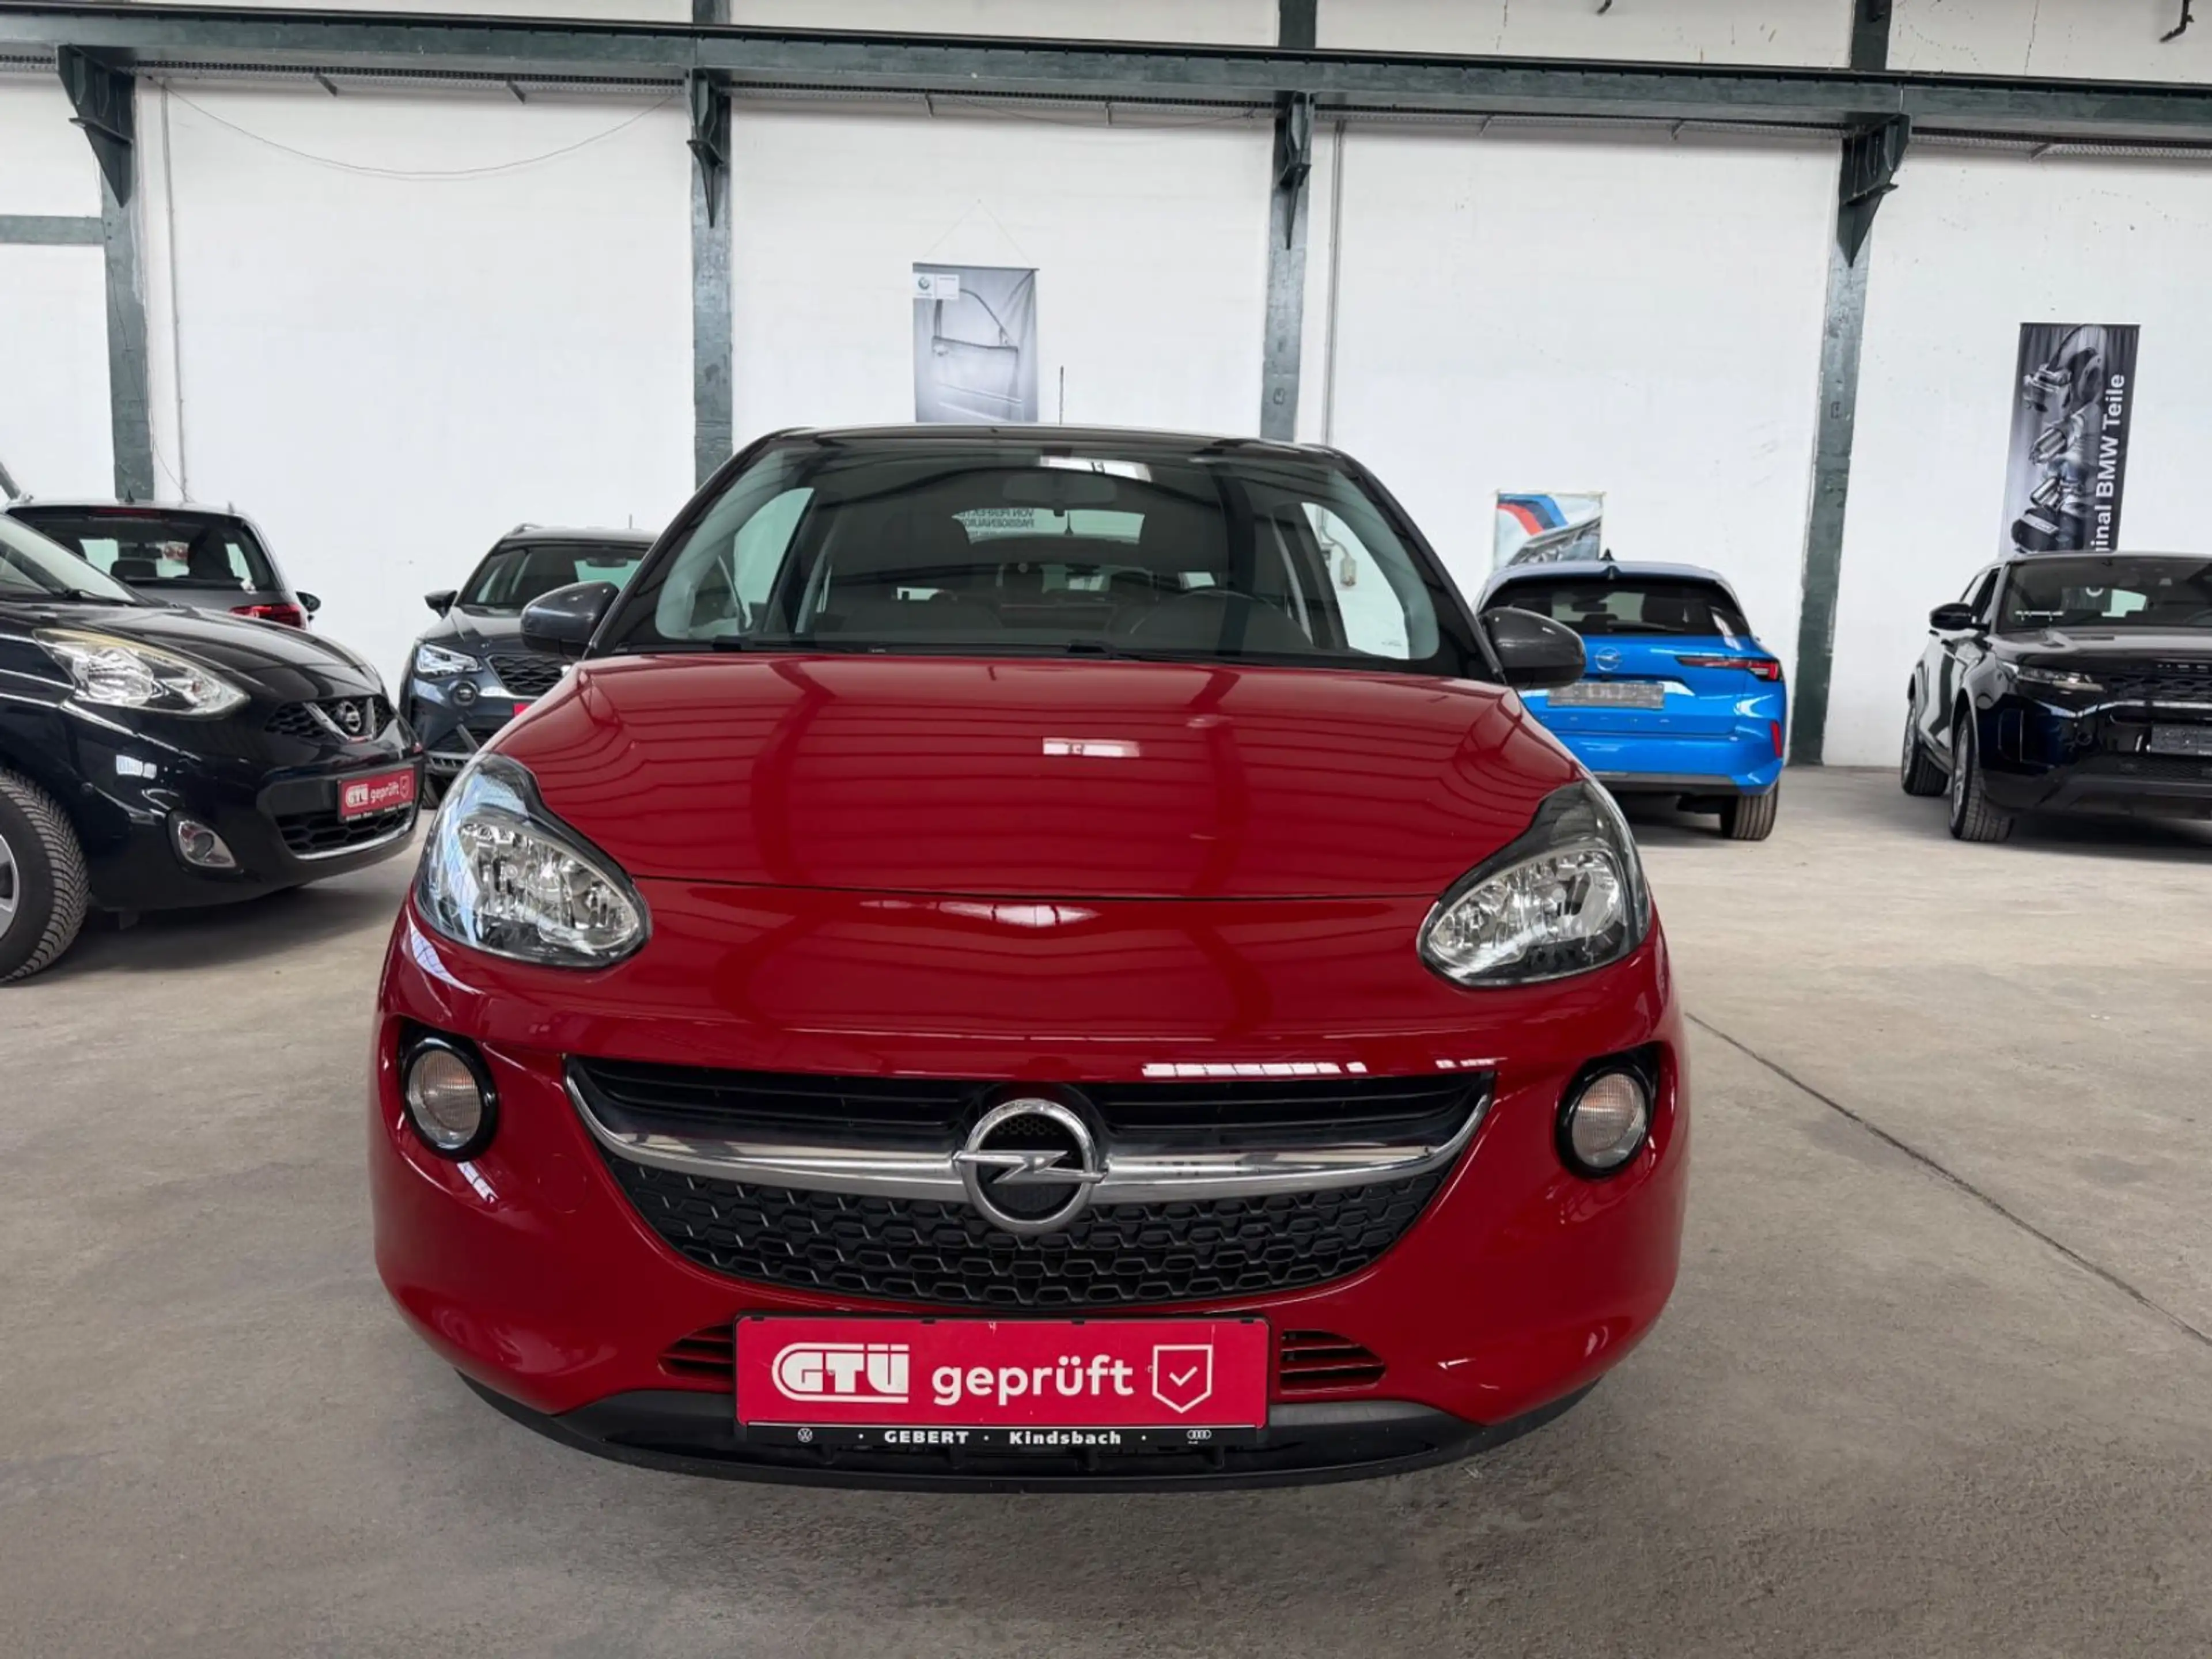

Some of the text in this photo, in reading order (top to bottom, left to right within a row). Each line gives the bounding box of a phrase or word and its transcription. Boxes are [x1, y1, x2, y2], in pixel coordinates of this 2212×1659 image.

[2090, 374, 2124, 552] inal BMW Teile
[775, 1343, 1134, 1406] GTÜ geprüft
[884, 1430, 969, 1444] GEBERT
[1009, 1431, 1122, 1445] Kindsbach
